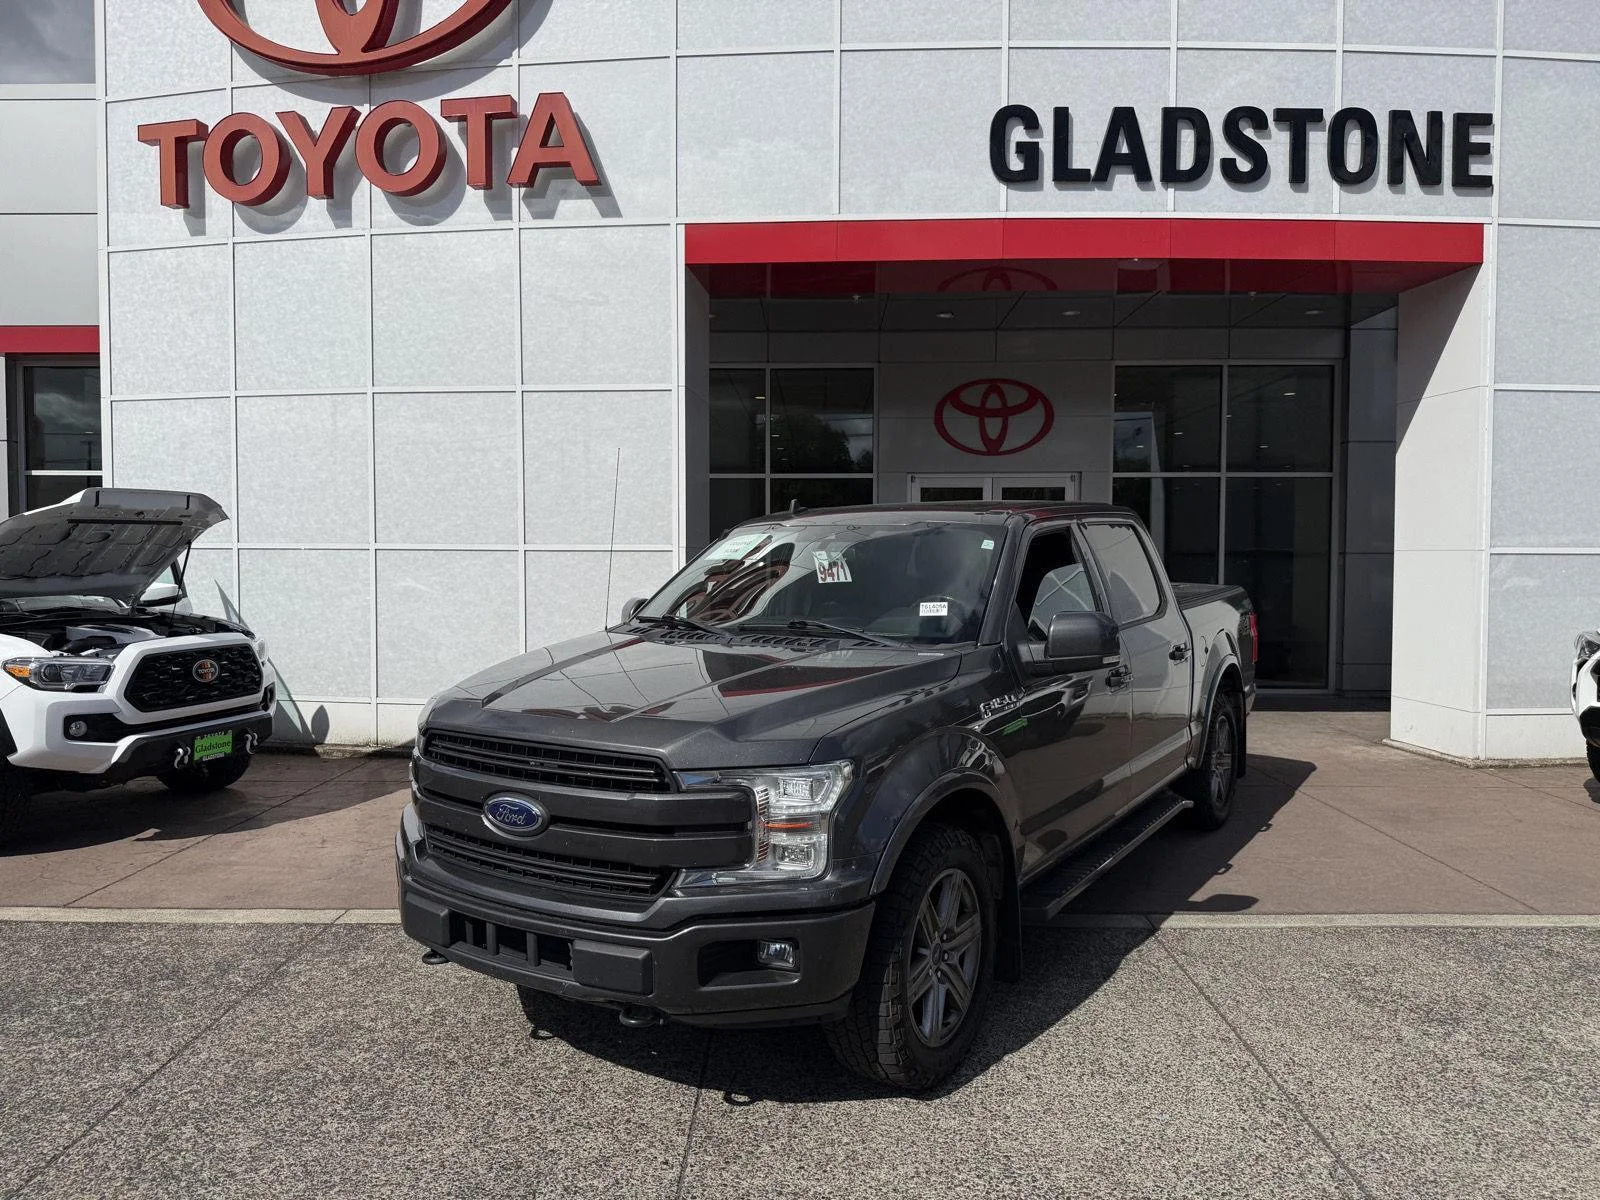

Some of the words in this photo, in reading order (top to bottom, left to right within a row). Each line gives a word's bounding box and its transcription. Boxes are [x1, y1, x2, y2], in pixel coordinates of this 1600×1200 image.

[138, 92, 602, 209] TOYOTA
[989, 104, 1493, 188] GLADSTONE
[195, 741, 231, 754] Gladstone
[496, 804, 526, 825] Ford
